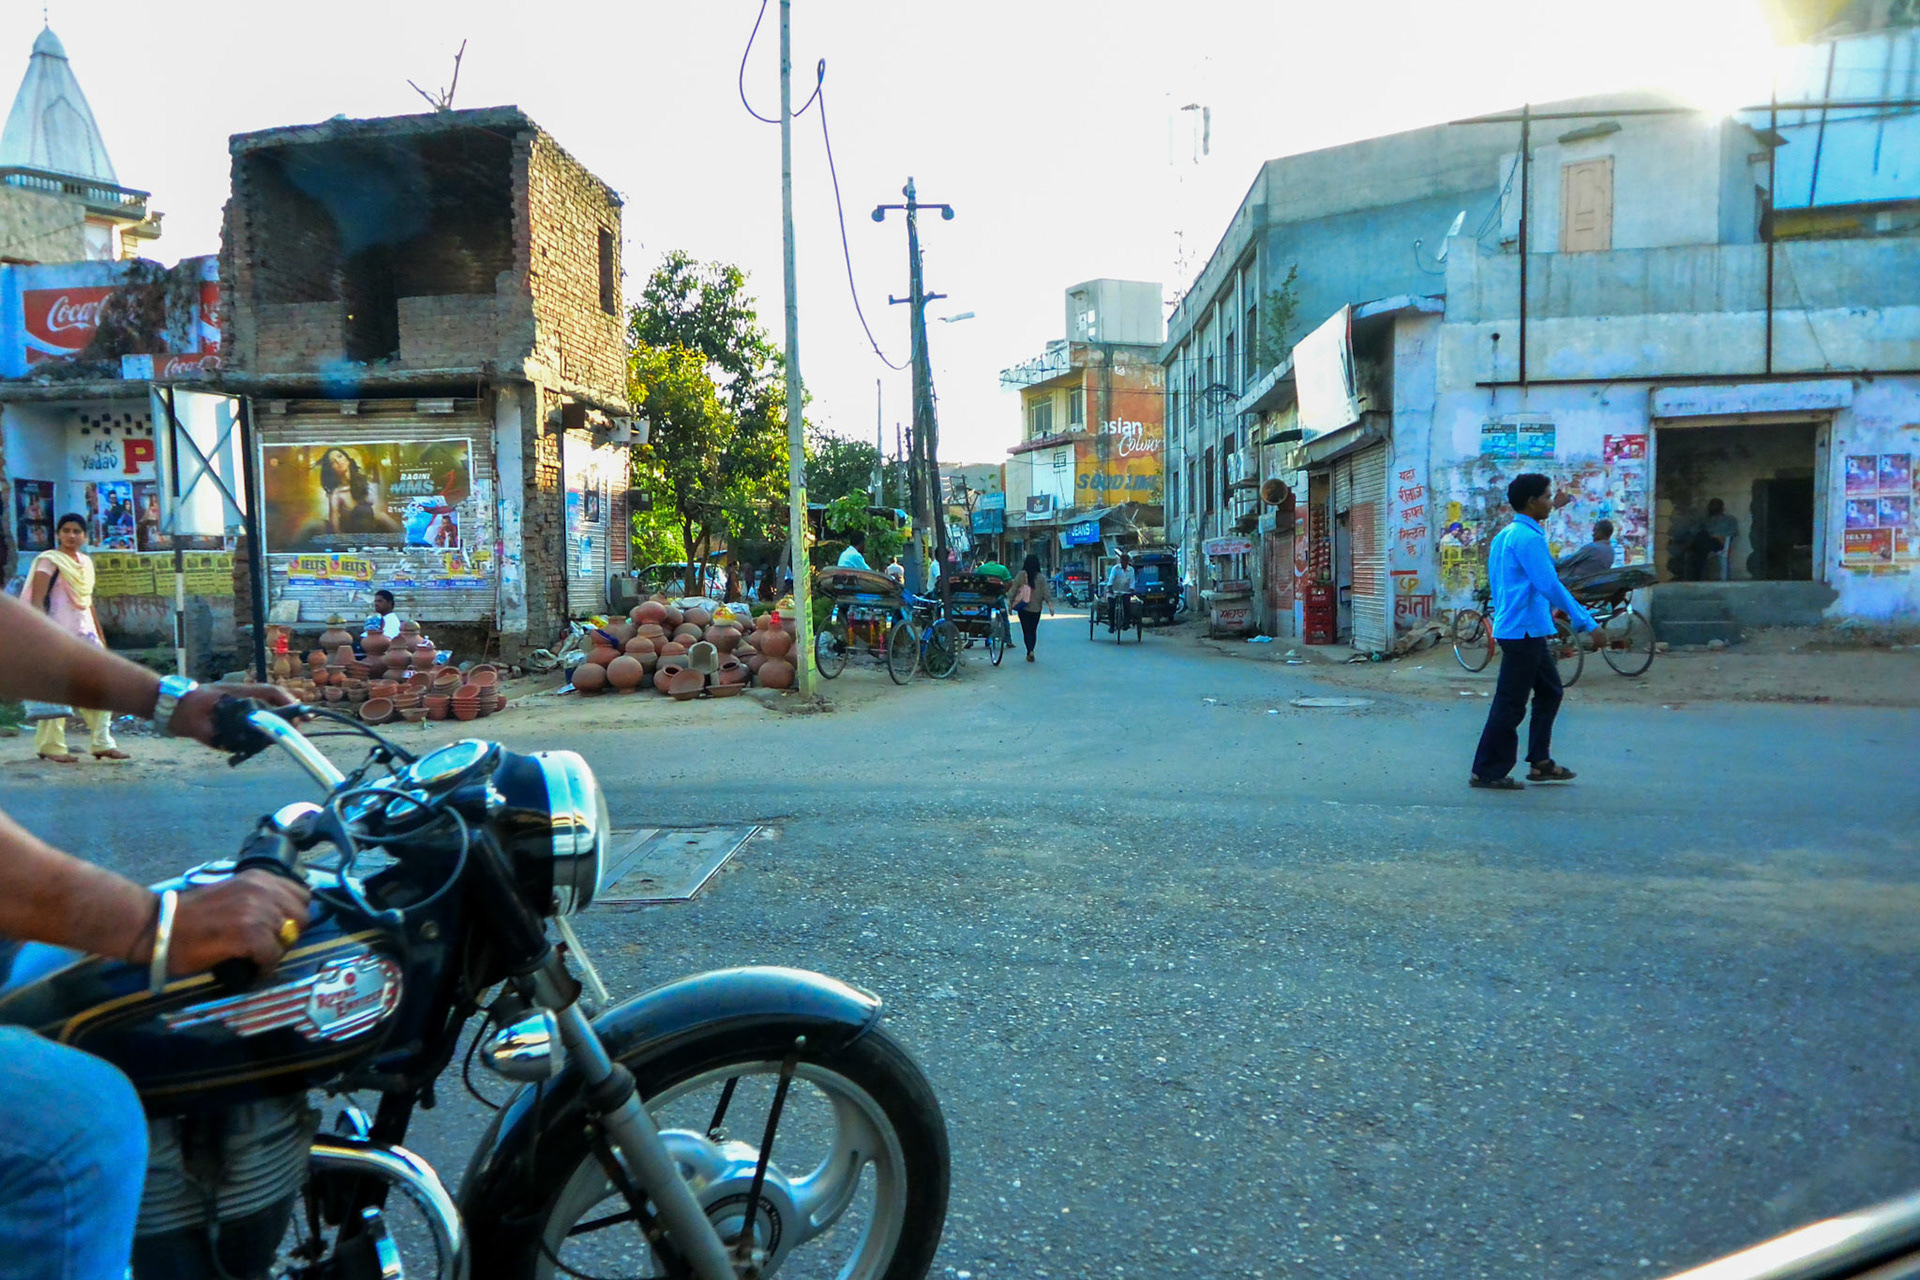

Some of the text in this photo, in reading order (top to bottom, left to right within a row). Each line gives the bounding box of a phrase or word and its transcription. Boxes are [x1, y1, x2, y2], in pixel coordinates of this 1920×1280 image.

[390, 480, 435, 495] MMS
[1072, 523, 1091, 537] JEANS
[301, 560, 327, 570] IELTS
[341, 561, 367, 571] IELTS
